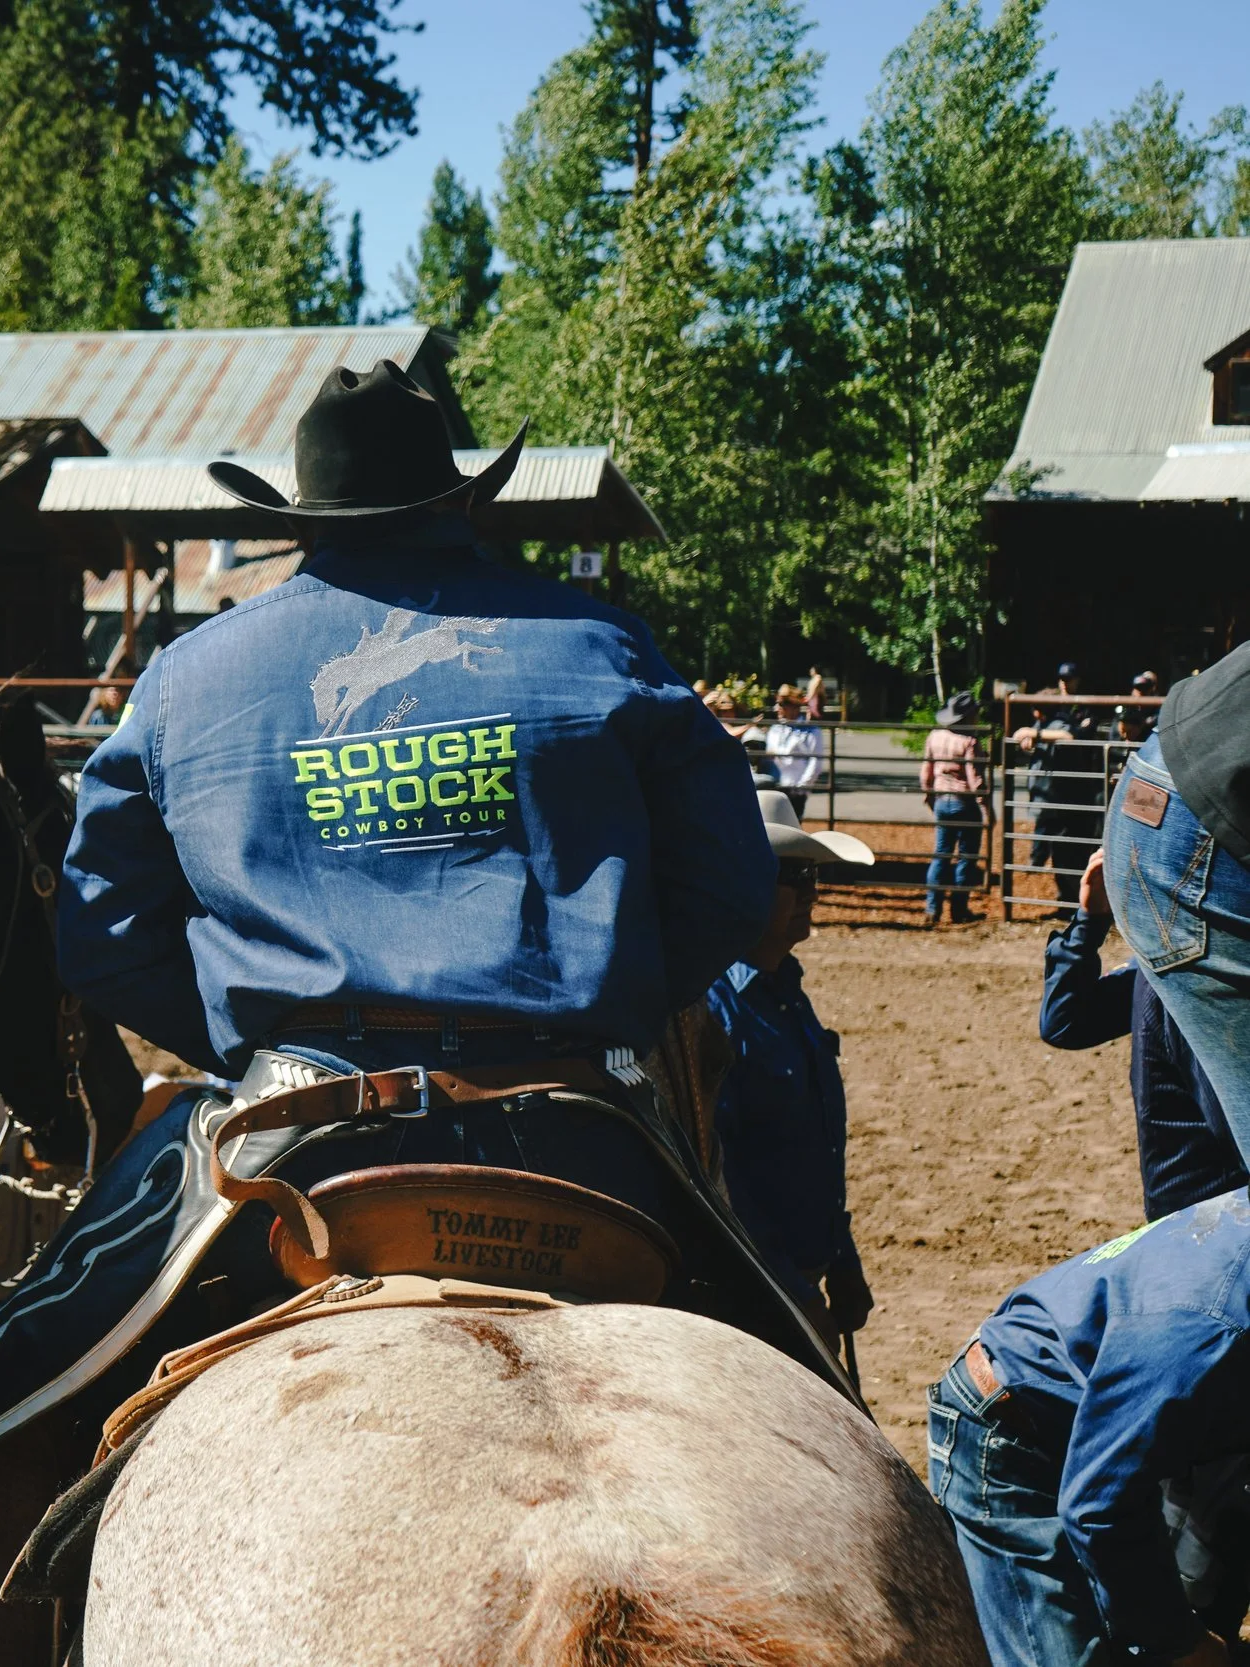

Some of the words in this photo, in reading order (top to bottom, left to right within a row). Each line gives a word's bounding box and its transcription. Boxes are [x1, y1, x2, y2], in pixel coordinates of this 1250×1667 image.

[580, 556, 593, 573] 8
[290, 724, 517, 783] ROUGH
[306, 766, 515, 821] STOCK
[320, 816, 425, 840] COWBOY
[444, 809, 507, 827] TOUR
[427, 1207, 530, 1244] TOMMY
[538, 1222, 583, 1251] LEE
[433, 1239, 566, 1276] LIVESTOCK
